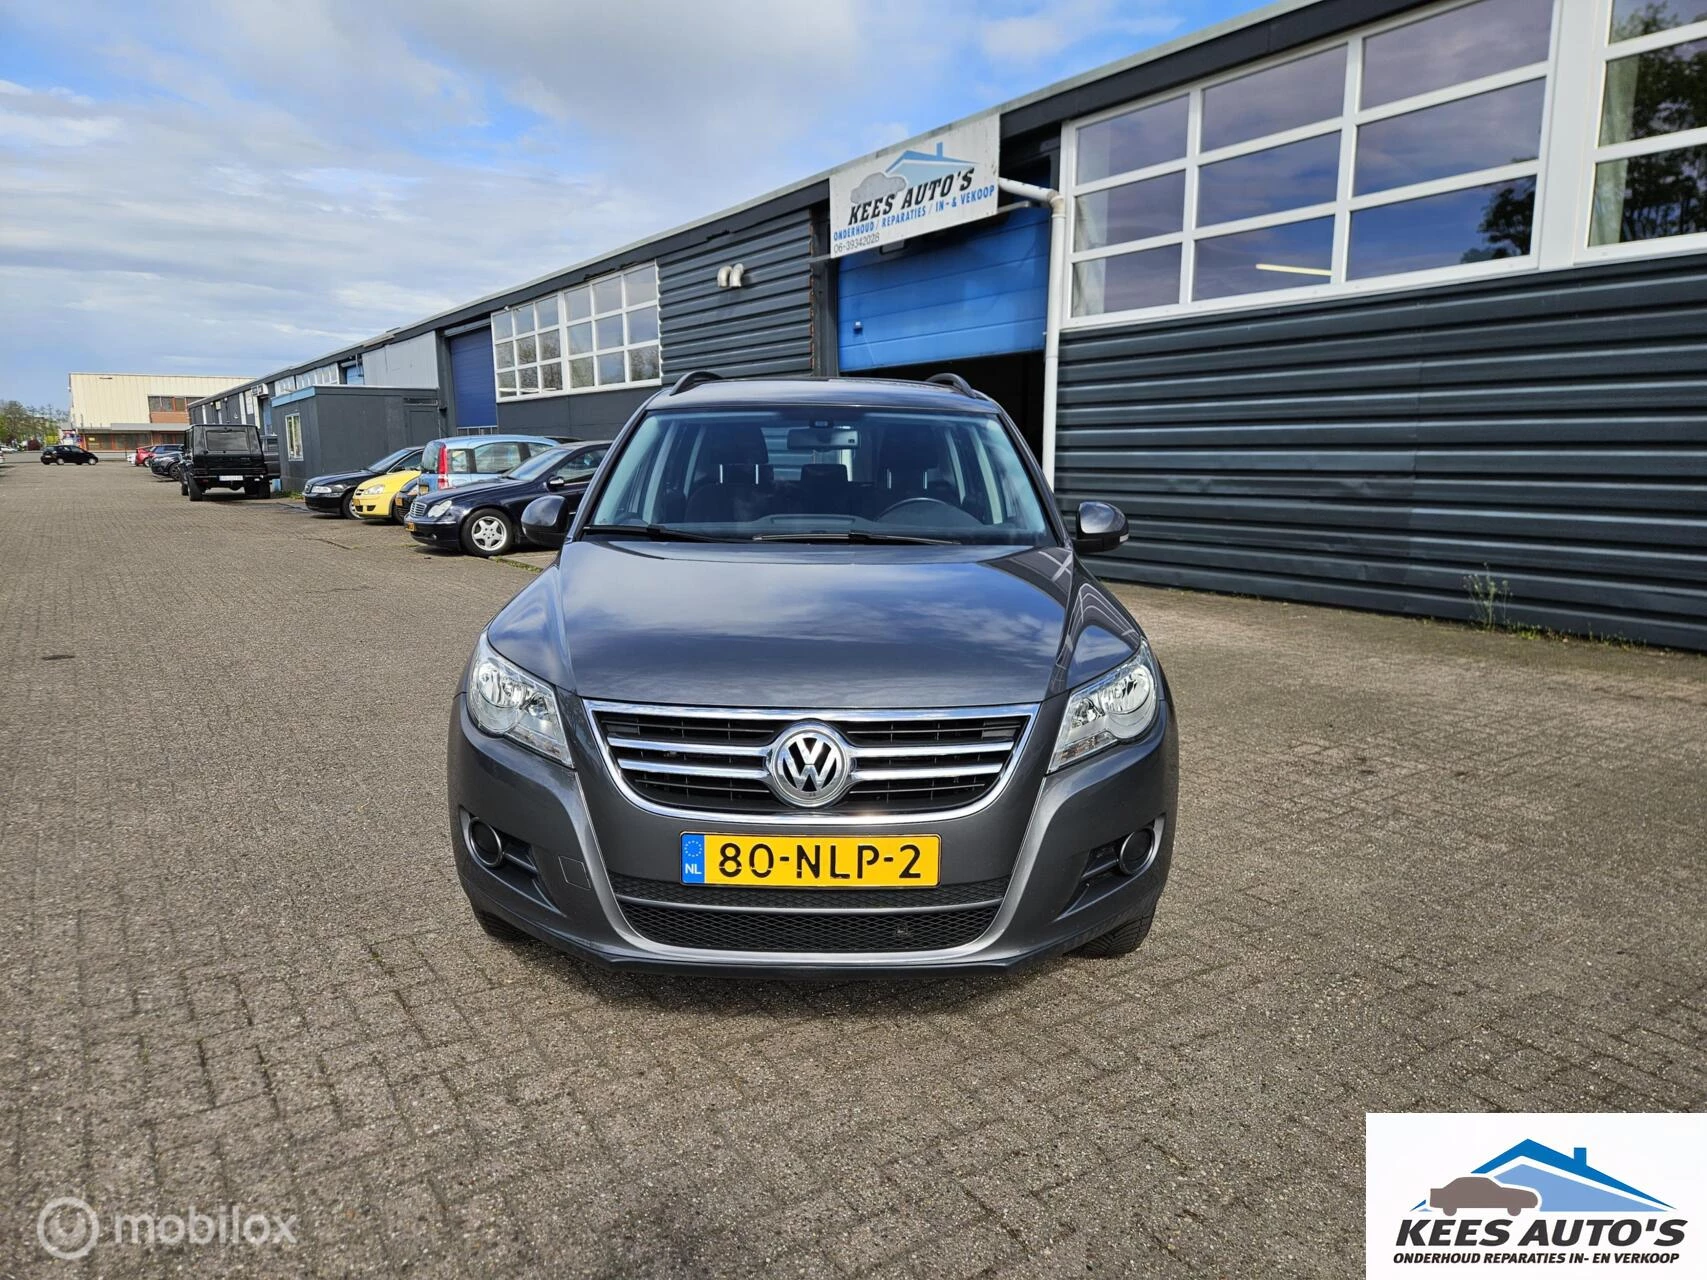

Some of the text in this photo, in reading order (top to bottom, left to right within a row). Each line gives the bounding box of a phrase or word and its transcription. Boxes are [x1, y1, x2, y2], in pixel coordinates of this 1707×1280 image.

[833, 221, 874, 241] ONDERHOUD
[882, 208, 926, 228] REPARATIES
[960, 184, 995, 205] VEKOOP
[848, 167, 975, 226] KEES AUTO'S
[783, 737, 837, 792] VW
[685, 842, 921, 879] NL 80-NLP-2
